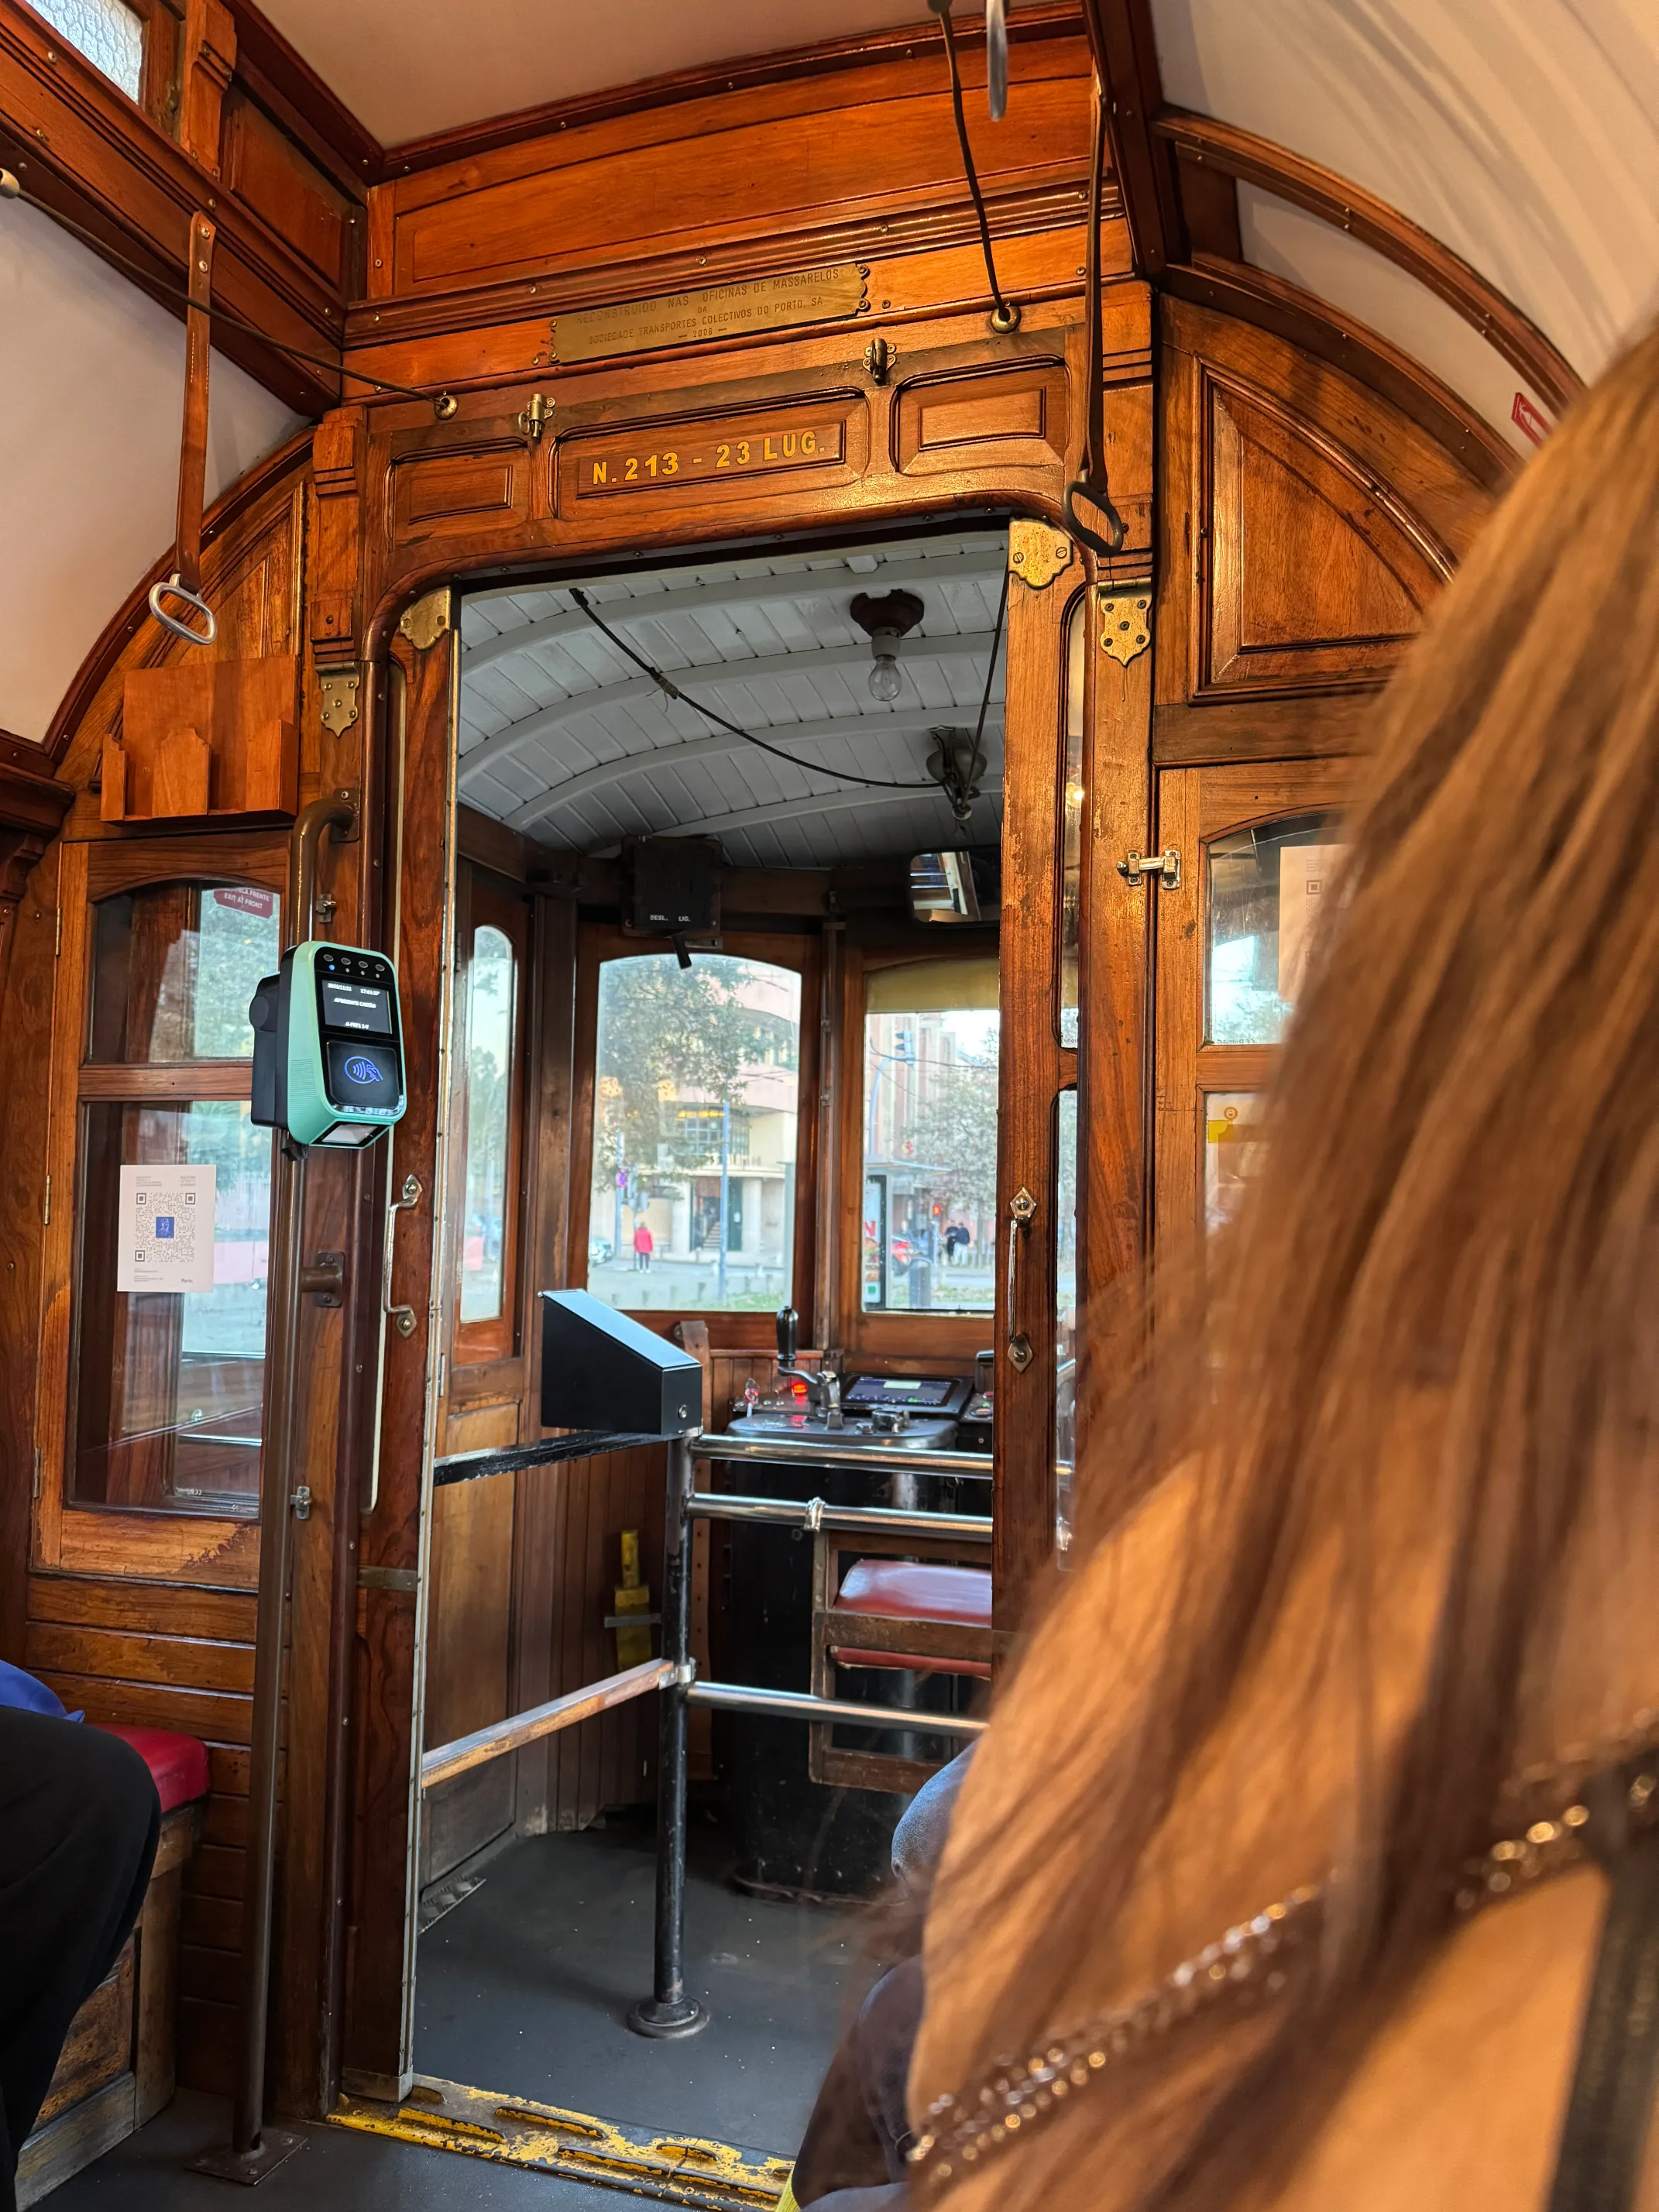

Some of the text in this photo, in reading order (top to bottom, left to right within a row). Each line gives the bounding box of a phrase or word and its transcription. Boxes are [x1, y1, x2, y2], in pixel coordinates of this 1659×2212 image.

[668, 295, 689, 308] NAS
[702, 285, 747, 302] OFICINAS
[754, 281, 767, 294] DE
[773, 269, 839, 290] MASSARELOS
[589, 328, 634, 345] SOCIEDADE
[638, 318, 696, 336] TRANSPORTES
[702, 309, 752, 325] COLECTIVOS
[757, 305, 770, 316] DO
[811, 296, 823, 307] SA
[692, 328, 713, 338] 2006
[716, 441, 750, 469] 23
[763, 431, 826, 461] LUG.
[224, 892, 236, 902] EXIT
[245, 898, 263, 909] FRONT
